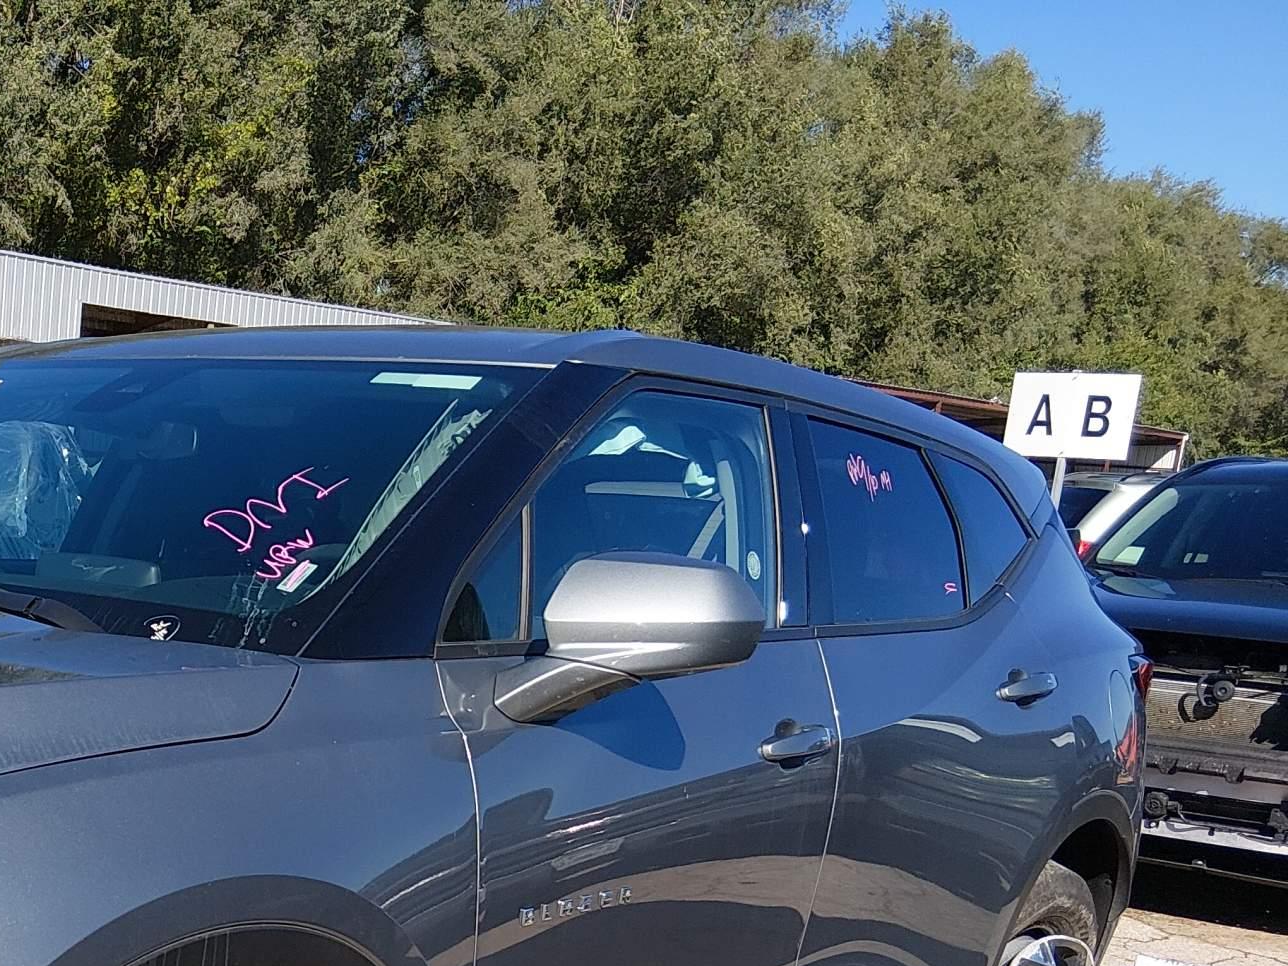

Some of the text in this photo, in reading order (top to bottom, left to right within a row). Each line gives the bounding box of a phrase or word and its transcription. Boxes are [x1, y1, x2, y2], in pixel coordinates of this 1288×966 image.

[1024, 393, 1113, 438] A B
[518, 886, 633, 927] BLAZER
